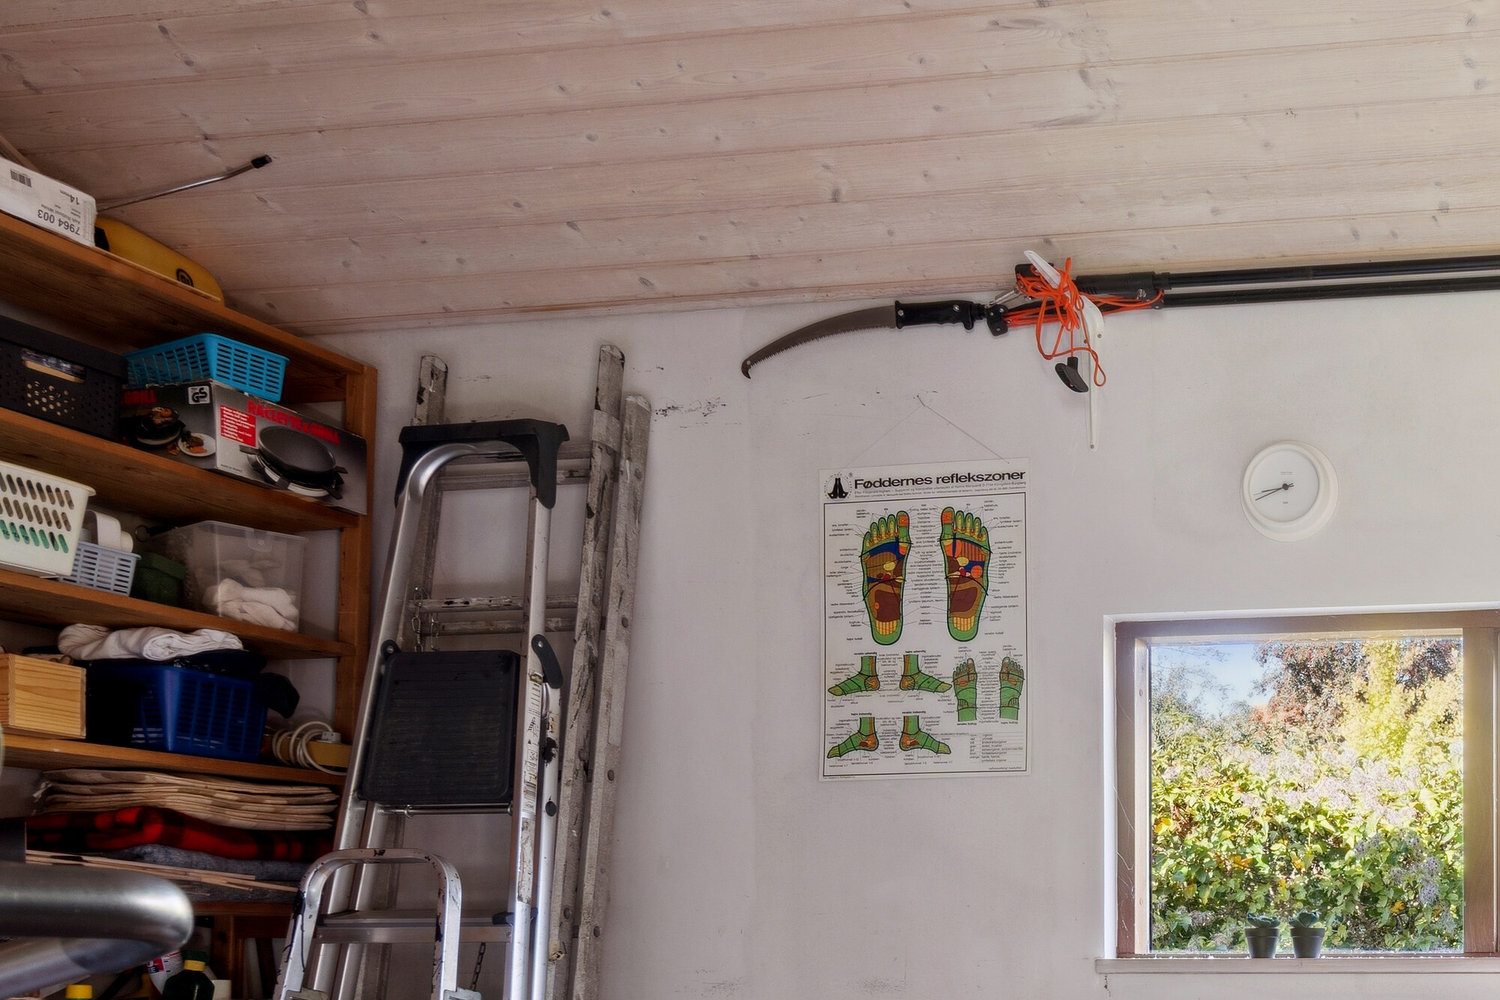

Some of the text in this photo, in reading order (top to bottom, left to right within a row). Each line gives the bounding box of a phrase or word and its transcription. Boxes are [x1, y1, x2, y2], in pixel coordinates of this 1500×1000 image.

[37, 209, 55, 224] 003
[58, 218, 80, 236] 7964
[854, 470, 1026, 490] Føddernes reflekszoner
